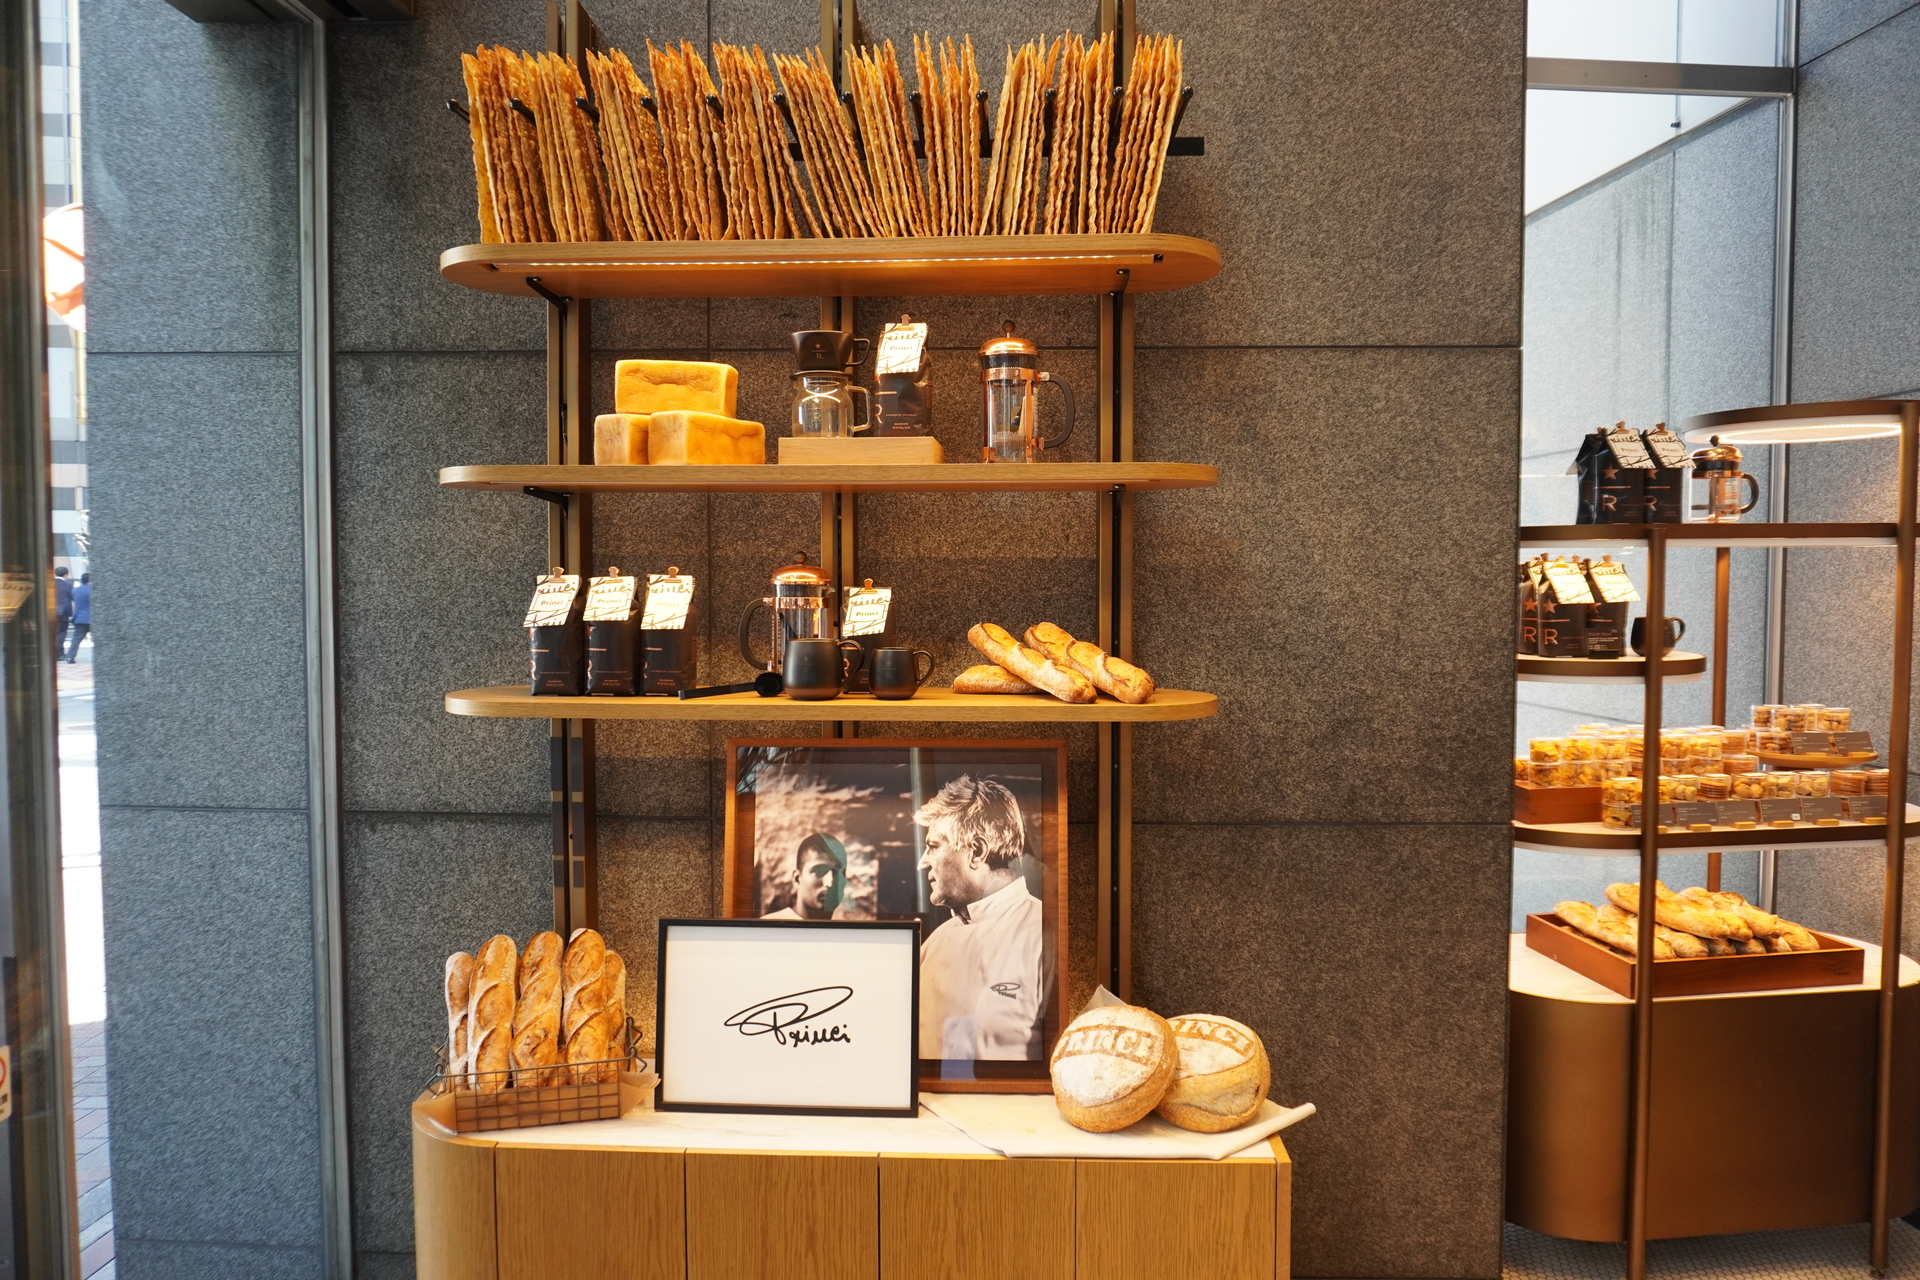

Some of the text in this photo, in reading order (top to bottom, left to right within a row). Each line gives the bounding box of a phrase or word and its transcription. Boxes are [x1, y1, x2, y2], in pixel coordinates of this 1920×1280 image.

[1602, 494, 1617, 511] R
[1523, 626, 1537, 643] R
[1544, 628, 1559, 645] R
